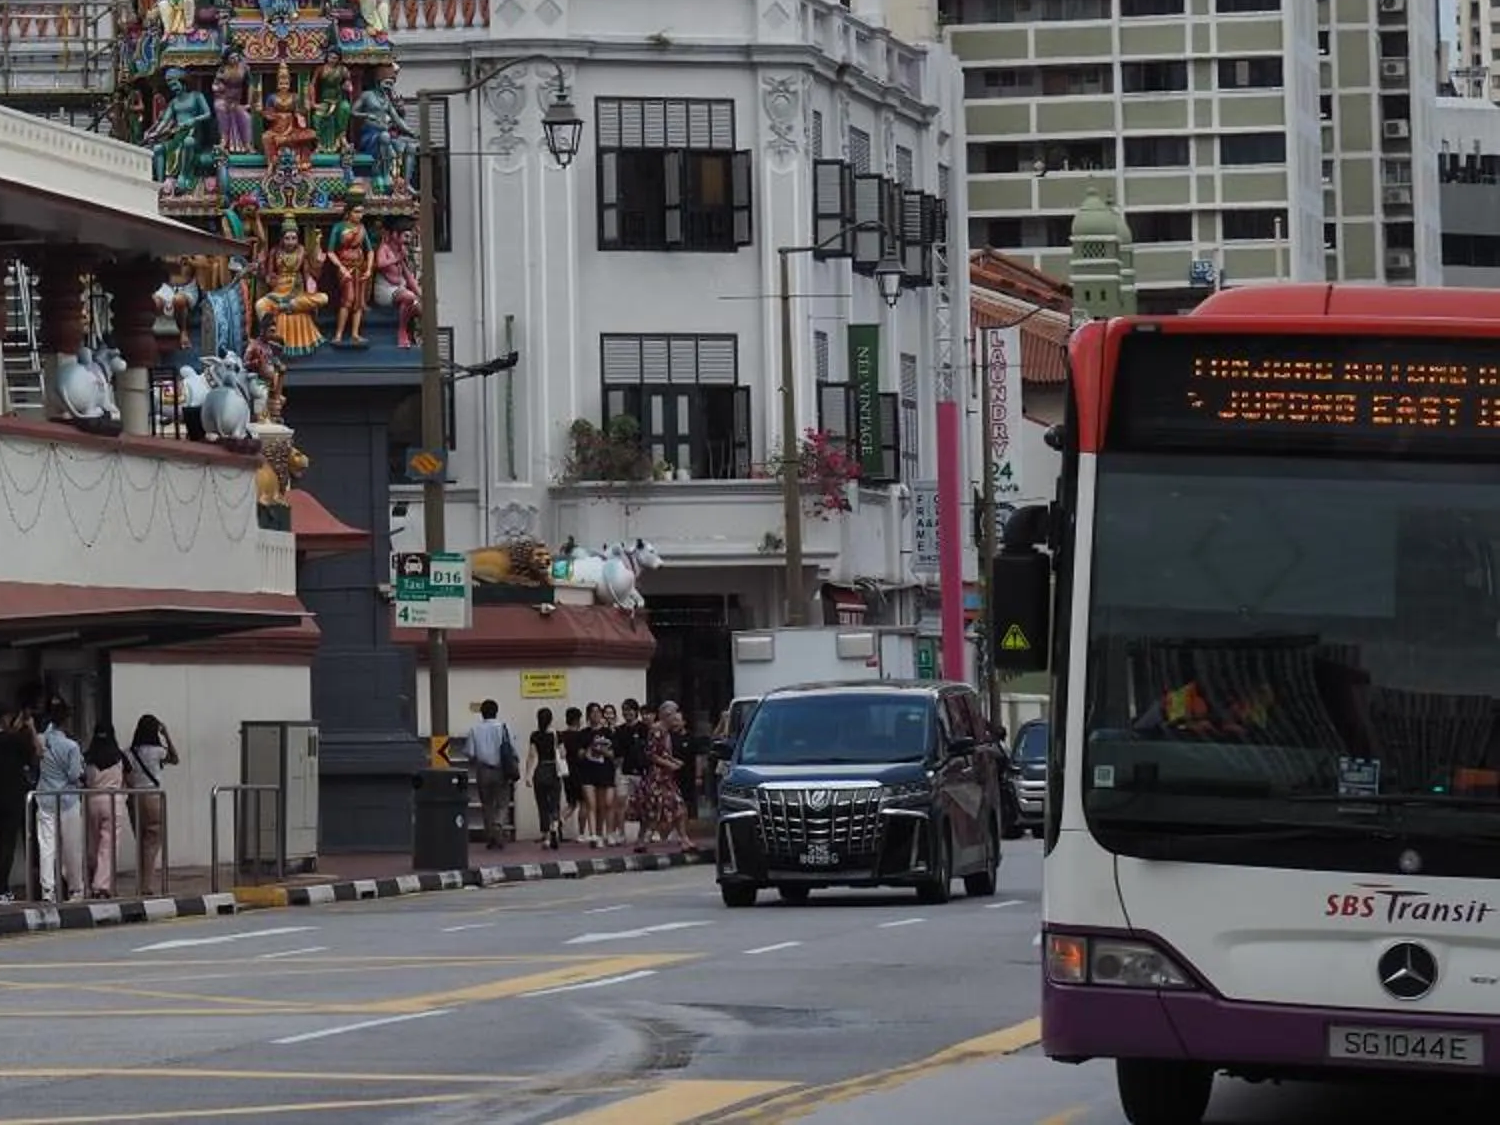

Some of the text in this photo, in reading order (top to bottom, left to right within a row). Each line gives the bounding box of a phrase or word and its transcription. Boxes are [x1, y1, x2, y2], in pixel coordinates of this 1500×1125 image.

[989, 330, 1009, 458] LAUNDRY
[1218, 391, 1357, 423] JURONG
[1372, 394, 1461, 426] EAST
[859, 382, 873, 456] VINTAGE
[433, 571, 462, 584] D16
[398, 606, 409, 622] 4
[1325, 890, 1498, 923] SBS Transit
[1345, 1032, 1468, 1060] SG1044E
